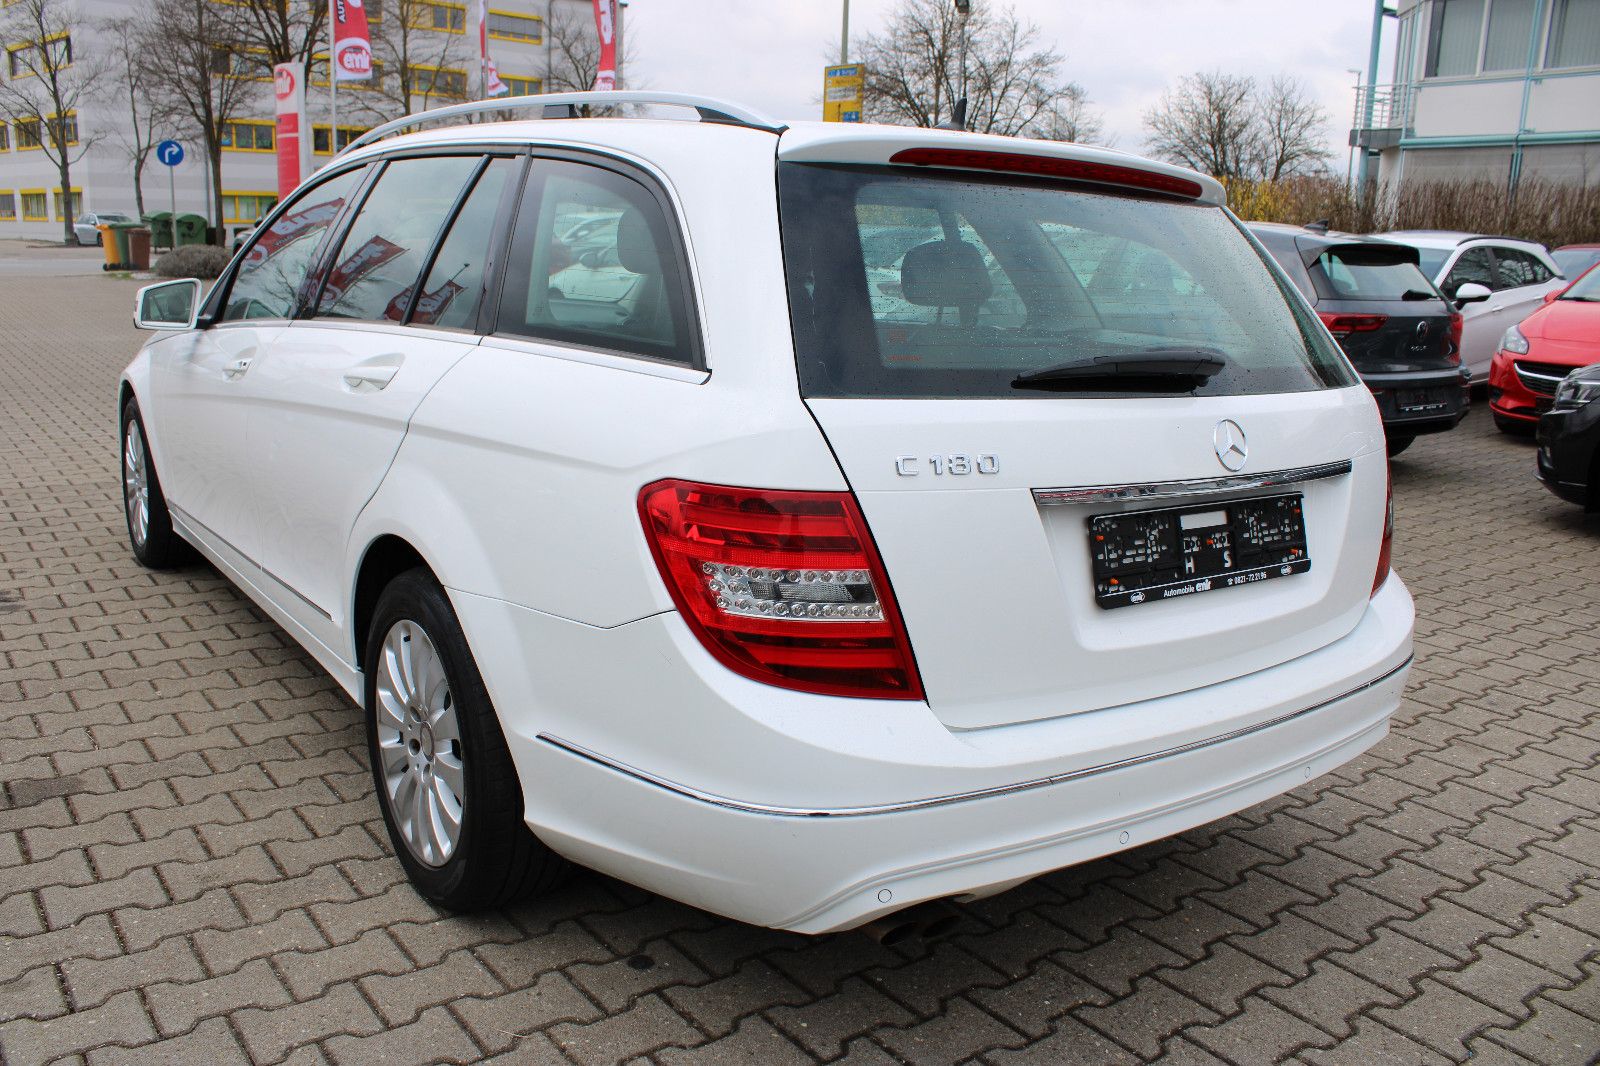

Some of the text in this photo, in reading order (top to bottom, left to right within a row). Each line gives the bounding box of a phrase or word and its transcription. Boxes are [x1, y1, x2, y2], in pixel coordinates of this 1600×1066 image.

[895, 453, 1001, 476] C 180
[1163, 584, 1195, 598] Automobile
